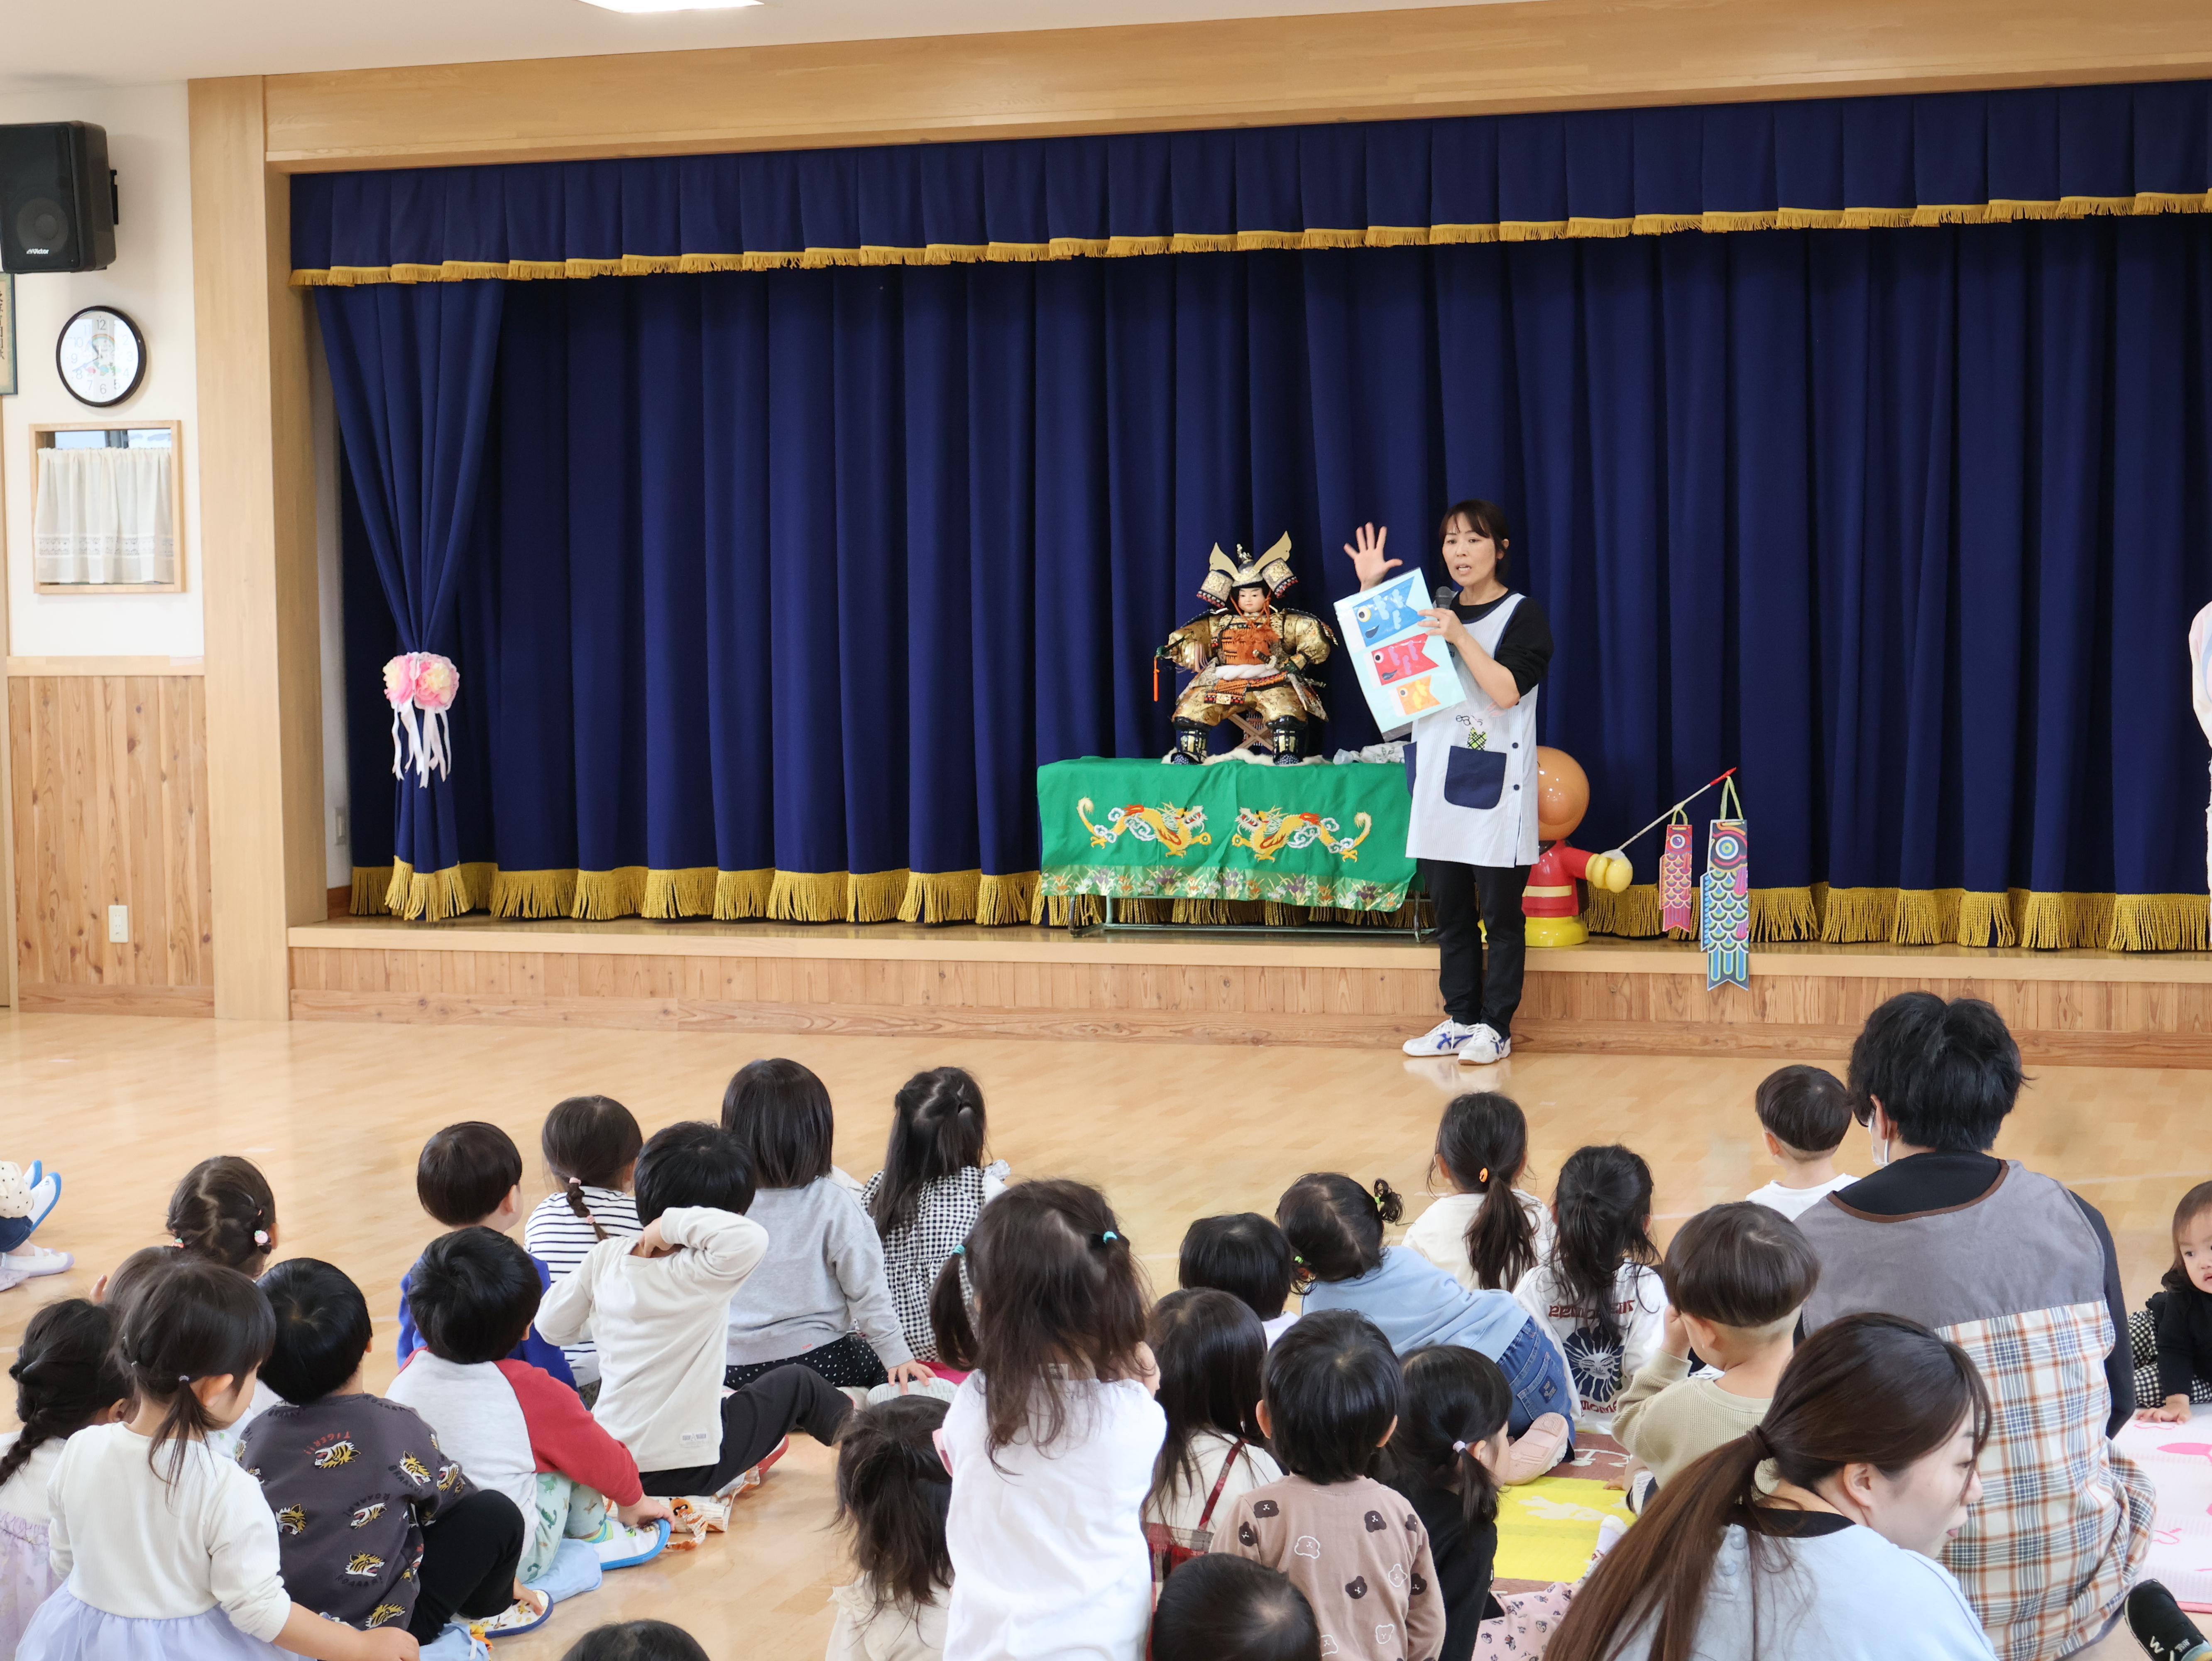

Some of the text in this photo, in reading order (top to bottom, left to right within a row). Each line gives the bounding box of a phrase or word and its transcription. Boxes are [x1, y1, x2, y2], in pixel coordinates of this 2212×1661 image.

[96, 319, 106, 330] 12
[83, 325, 91, 335] 11
[74, 337, 83, 348] 10
[122, 335, 128, 345] 2
[71, 353, 78, 363] 9
[127, 351, 133, 362] 3
[76, 369, 83, 380] 8
[123, 368, 129, 377] 4
[87, 380, 93, 390] 7
[100, 384, 107, 394] 6
[114, 379, 121, 390] 5
[303, 1431, 350, 1454] TIGER!!
